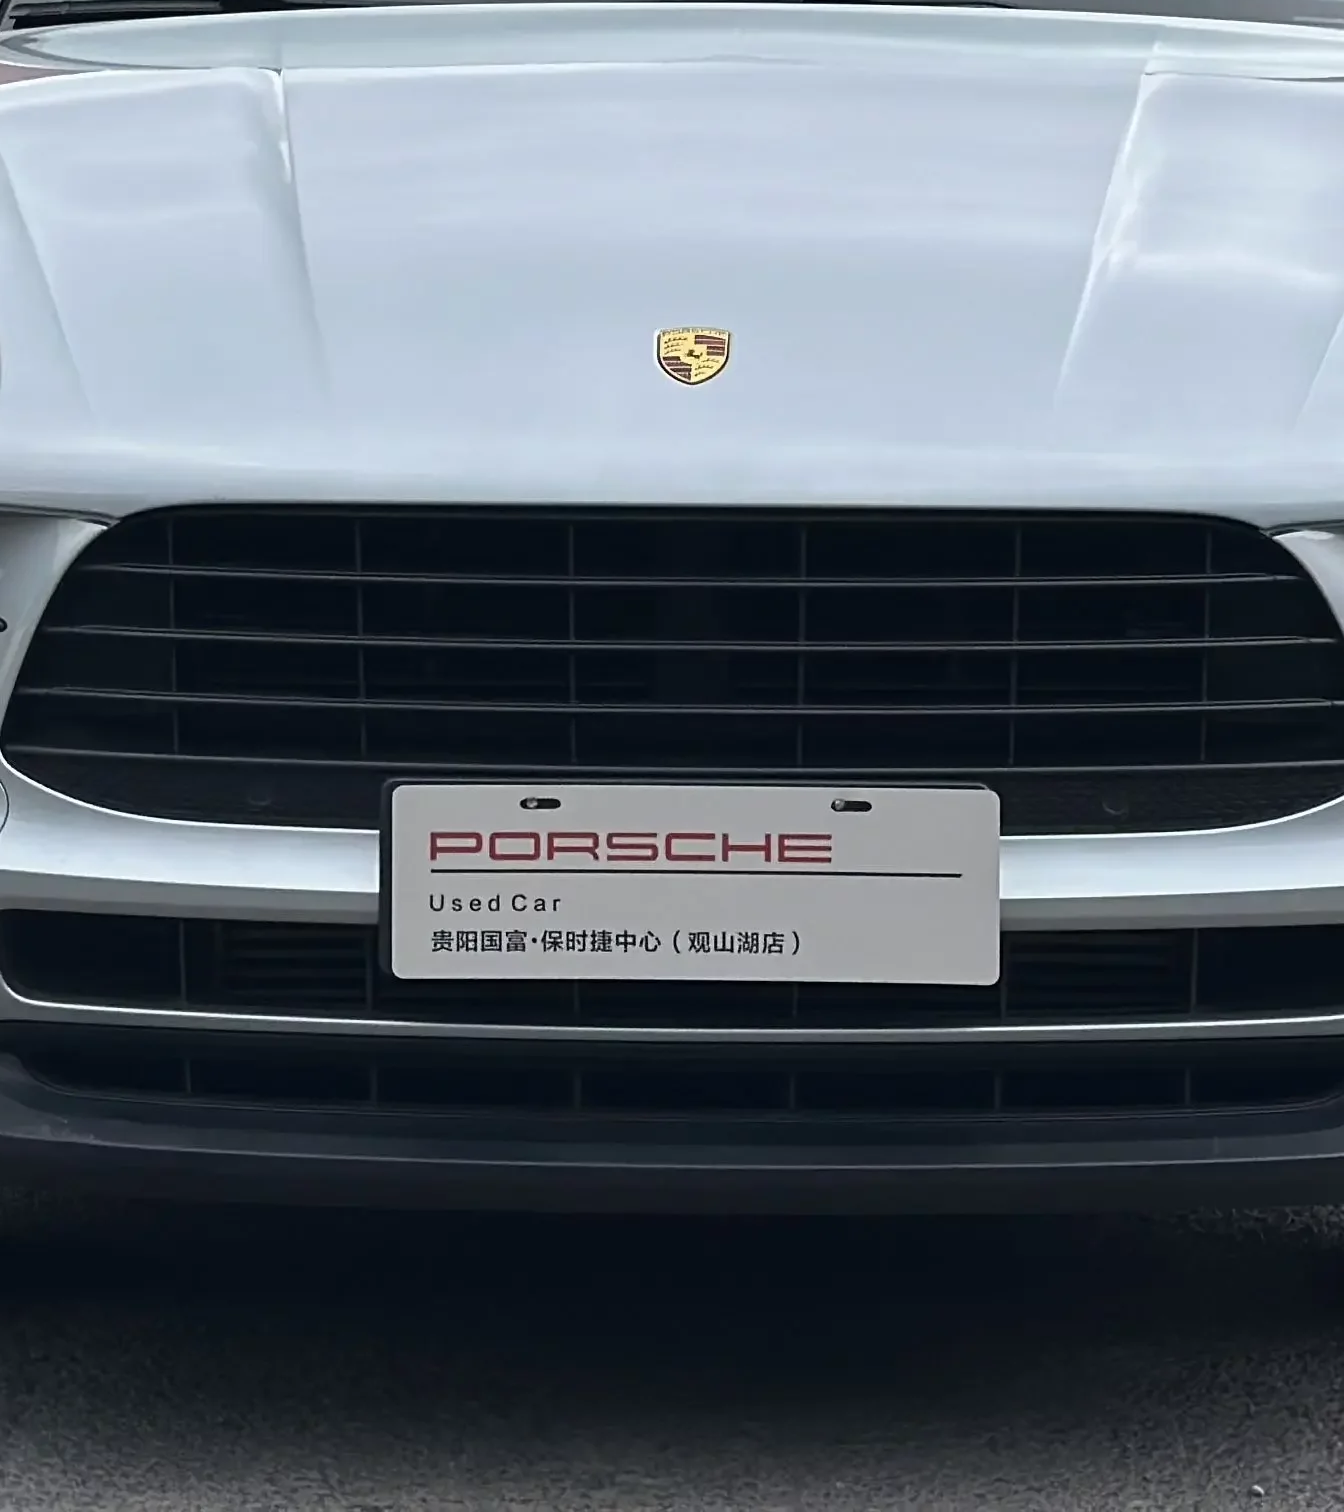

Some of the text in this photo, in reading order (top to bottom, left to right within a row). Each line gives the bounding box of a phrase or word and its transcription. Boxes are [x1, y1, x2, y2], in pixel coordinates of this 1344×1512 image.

[429, 832, 833, 864] PORSCHE
[429, 894, 561, 912] Used Car
